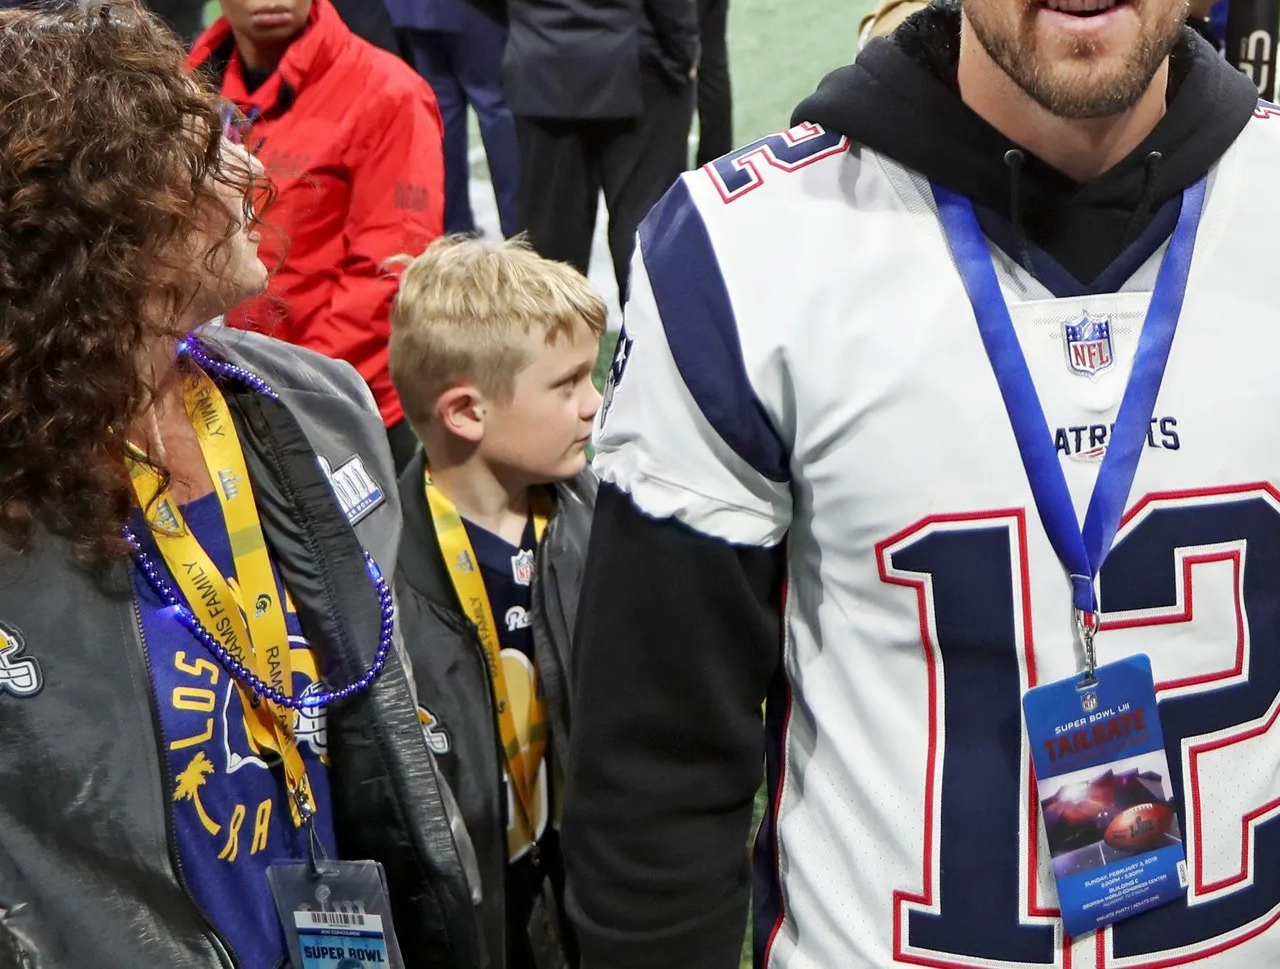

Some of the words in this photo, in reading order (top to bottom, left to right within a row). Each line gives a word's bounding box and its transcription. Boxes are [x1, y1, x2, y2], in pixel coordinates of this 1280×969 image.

[1072, 341, 1109, 369] NFL
[1055, 416, 1181, 456] ATRTS
[181, 561, 224, 618] FAMILY
[215, 617, 246, 663] RAMS
[169, 650, 220, 751] LOS
[1055, 717, 1087, 734] SUPER
[1089, 708, 1116, 723] BOWL
[1118, 702, 1130, 712] LIII
[1043, 708, 1147, 762] TAILGATE
[1109, 862, 1139, 878] FEBRUARY
[1109, 881, 1135, 893] BUILDING
[1083, 898, 1104, 910] GEORGIA
[1104, 891, 1123, 902] WORLD
[1122, 882, 1148, 895] CONGRESS
[1148, 874, 1167, 885] CENTER
[304, 945, 345, 960] SUPER
[348, 947, 385, 963] BOWL
